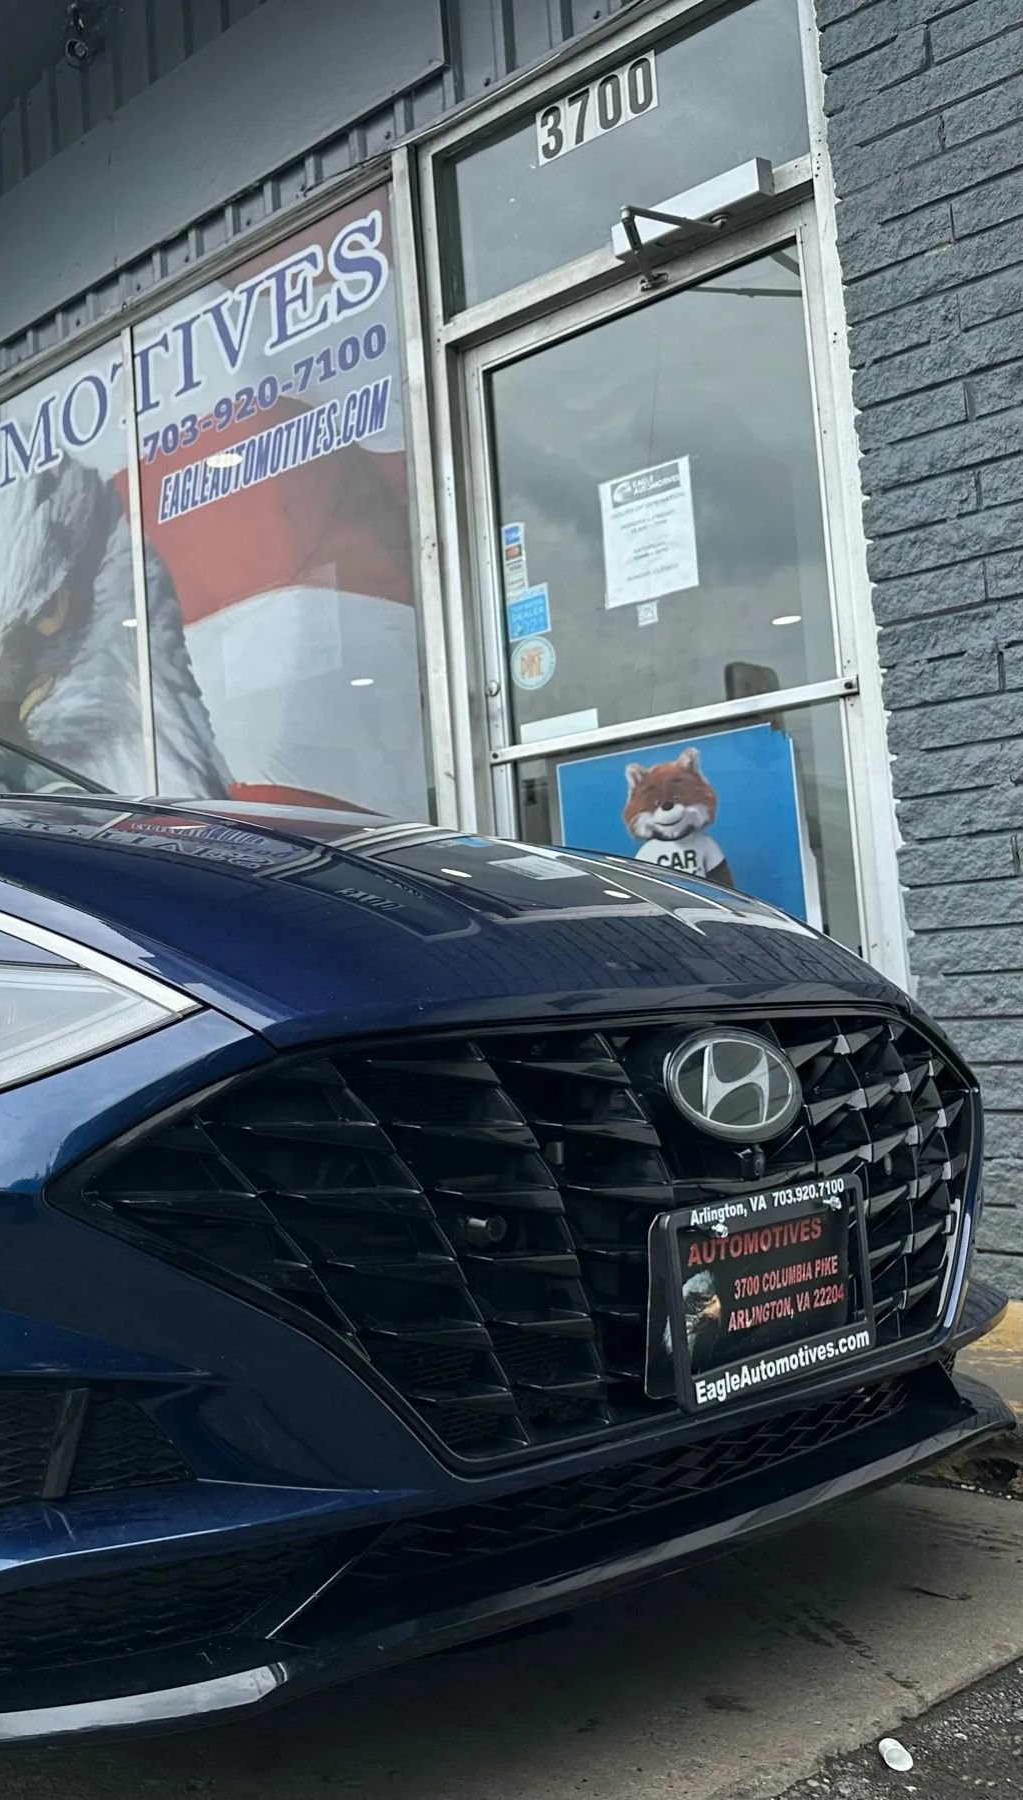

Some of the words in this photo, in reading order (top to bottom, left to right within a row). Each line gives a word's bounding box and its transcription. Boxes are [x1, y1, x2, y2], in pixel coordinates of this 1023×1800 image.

[540, 57, 653, 159] 3700
[143, 324, 387, 464] 703-920-7100
[158, 376, 392, 524] EAGLEAUTOMOTIVES.COM
[657, 849, 697, 870] CAR
[690, 1203, 748, 1226] Arlington,
[749, 1194, 767, 1213] VA
[772, 1177, 845, 1208] 703.920.7100
[688, 1217, 822, 1267] AUTOMOTIVES
[734, 1274, 760, 1300] 3700
[762, 1261, 812, 1293] COLUMBIA
[815, 1254, 838, 1279] PIKE
[728, 1296, 794, 1333] ARLINGTON,
[796, 1291, 811, 1312] VA
[813, 1282, 845, 1309] 22204
[695, 1330, 870, 1404] EagleAutomotives.com
